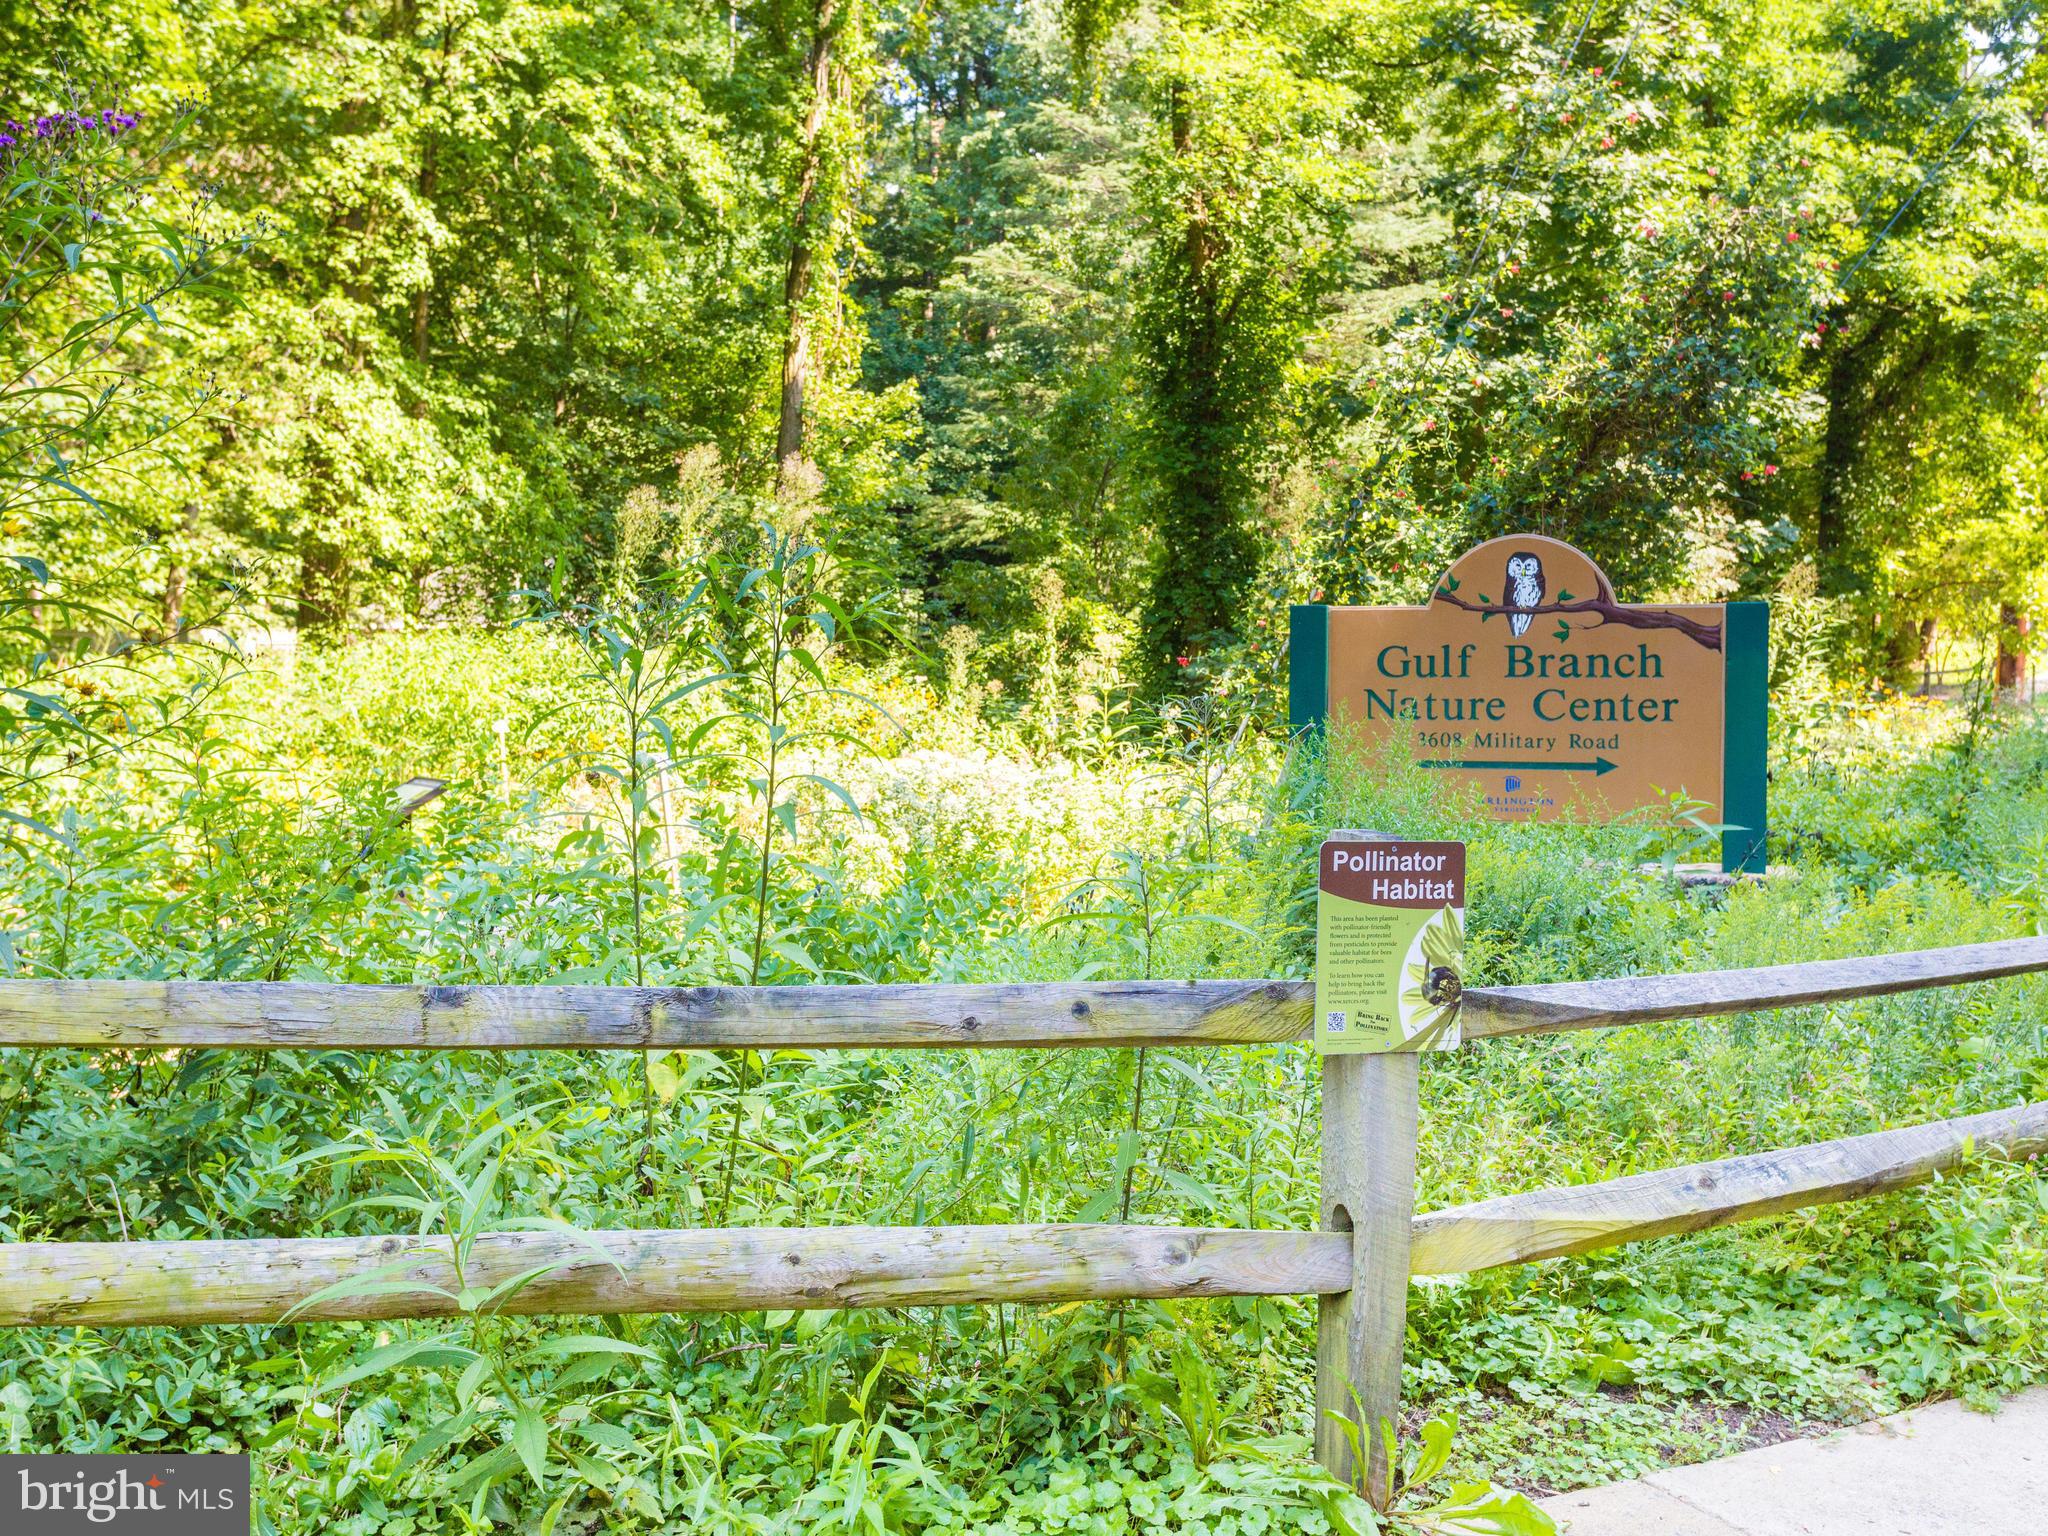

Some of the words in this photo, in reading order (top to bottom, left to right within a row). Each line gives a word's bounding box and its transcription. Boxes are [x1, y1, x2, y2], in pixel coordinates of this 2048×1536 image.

[1376, 644, 1476, 680] Gulf
[1504, 643, 1665, 680] Branch
[1364, 688, 1506, 722] Nature
[1533, 688, 1679, 724] Center
[1418, 731, 1463, 748] 3608
[1474, 732, 1557, 752] Military
[1569, 733, 1620, 750] Road
[1333, 851, 1446, 872] Pollinator
[1372, 878, 1455, 900] Habitat
[1379, 914, 1399, 923] planted
[1344, 941, 1370, 949] pesticides
[1377, 940, 1398, 948] provide
[1367, 932, 1392, 940] protected
[1359, 989, 1376, 997] please
